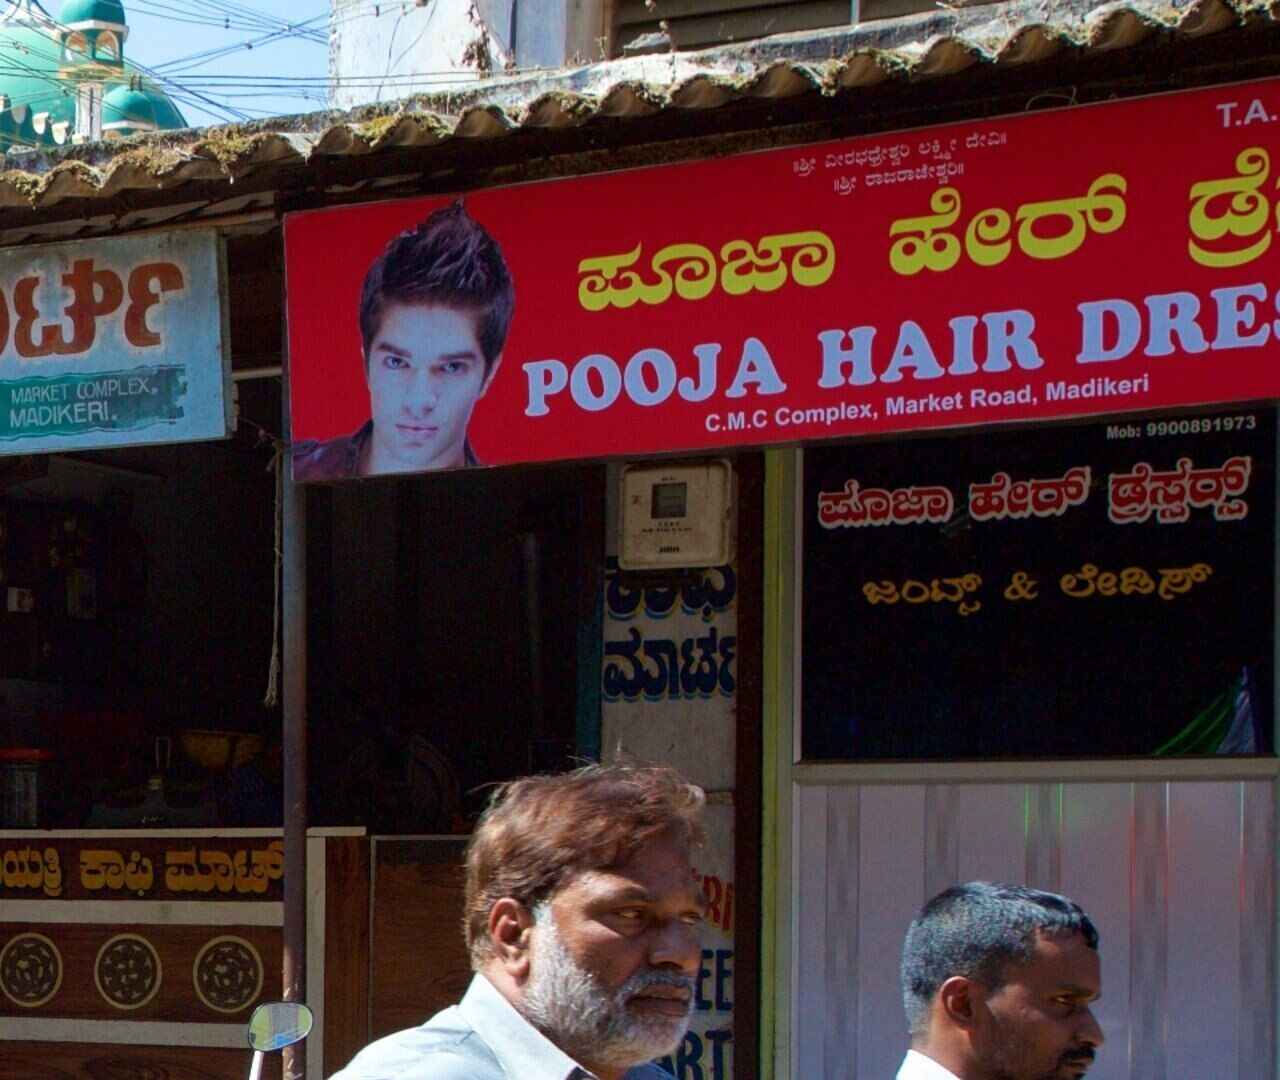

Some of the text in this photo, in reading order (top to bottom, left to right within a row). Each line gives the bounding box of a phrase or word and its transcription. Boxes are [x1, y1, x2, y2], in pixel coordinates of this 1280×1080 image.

[577, 146, 1280, 312] ಪೂಜಾ ಹೇರ್ ಡ್ರೆ
[522, 281, 1280, 417] POOJA HAIR DRE
[9, 401, 118, 429] MADIKERI.
[10, 384, 69, 405] MARKET
[704, 374, 1150, 432] C.M.C Complex, Market Road, Madikeri
[1106, 415, 1257, 440] Mob: 9900891973
[818, 478, 954, 528] ಪೂಜಾ
[969, 466, 1092, 519] ಹೇರ್
[1003, 570, 1039, 601] &
[79, 850, 153, 896] ಕಾಫಿ
